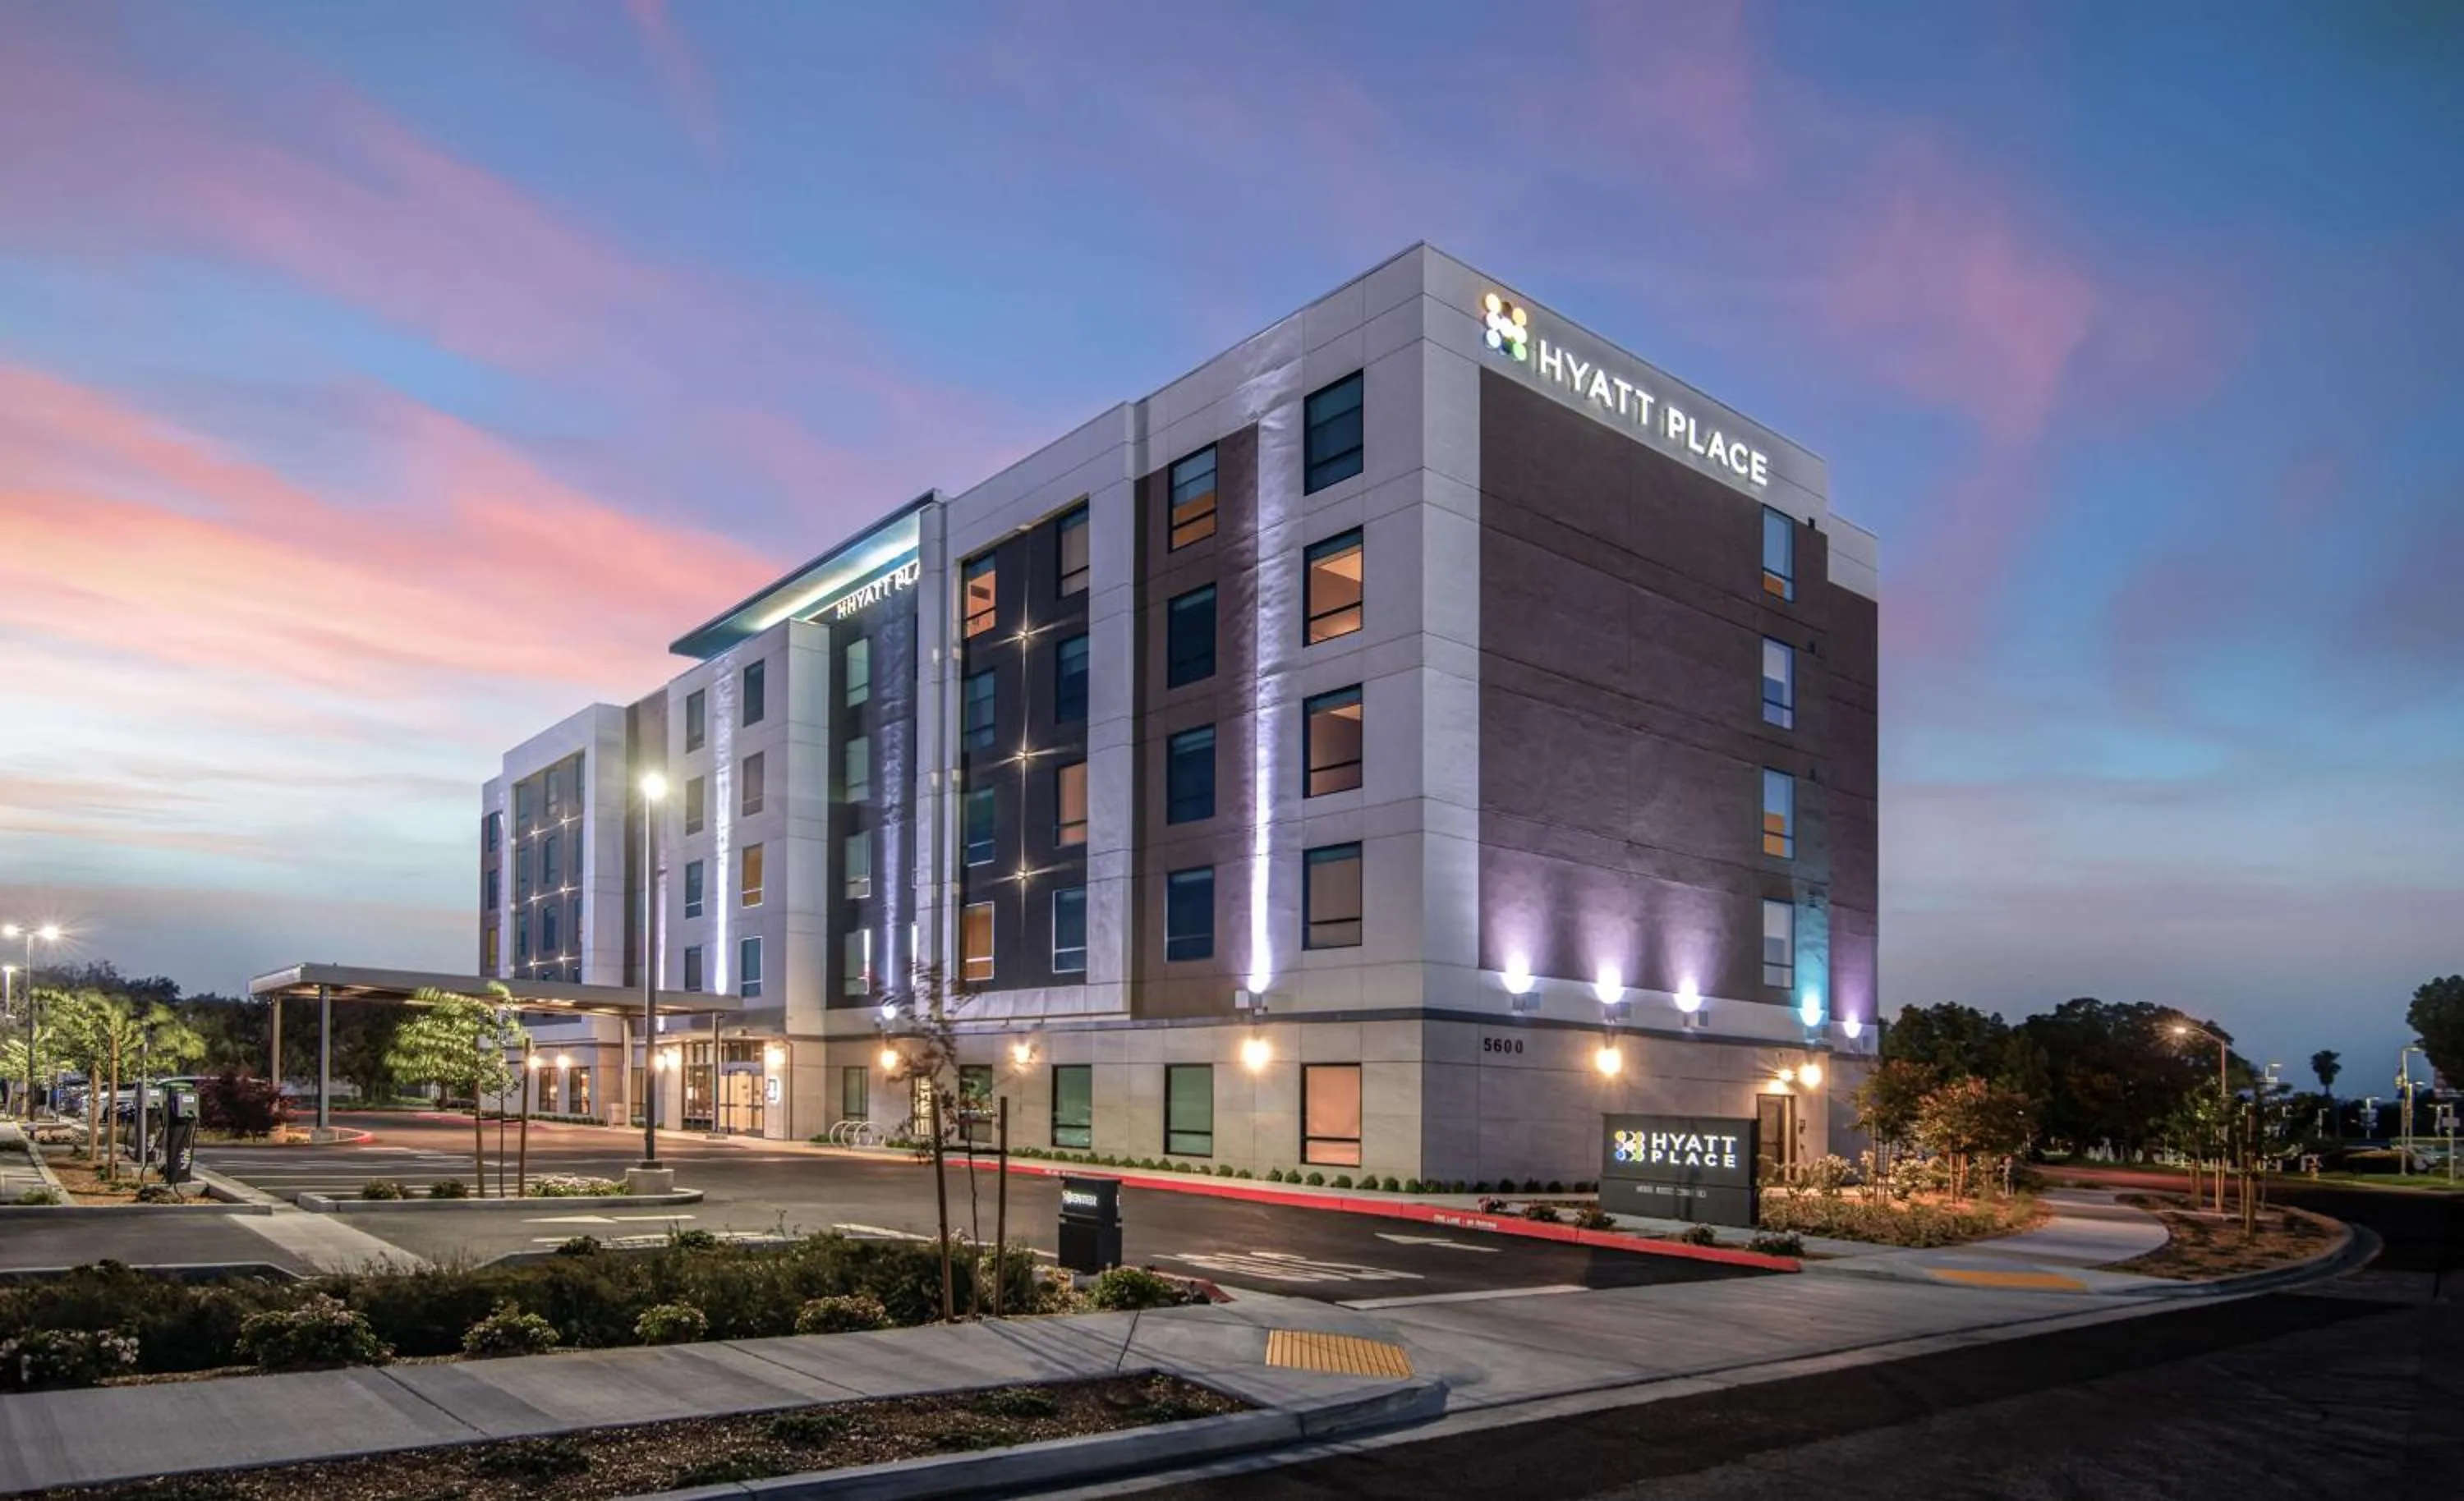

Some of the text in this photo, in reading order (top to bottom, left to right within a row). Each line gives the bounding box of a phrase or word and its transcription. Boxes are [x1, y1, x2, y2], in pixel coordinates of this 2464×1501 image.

[1538, 339, 1768, 486] HYATT PLACE
[1483, 1037, 1524, 1054] 5600
[1652, 1132, 1737, 1153] HYATT
[1651, 1150, 1736, 1168] PLACE
